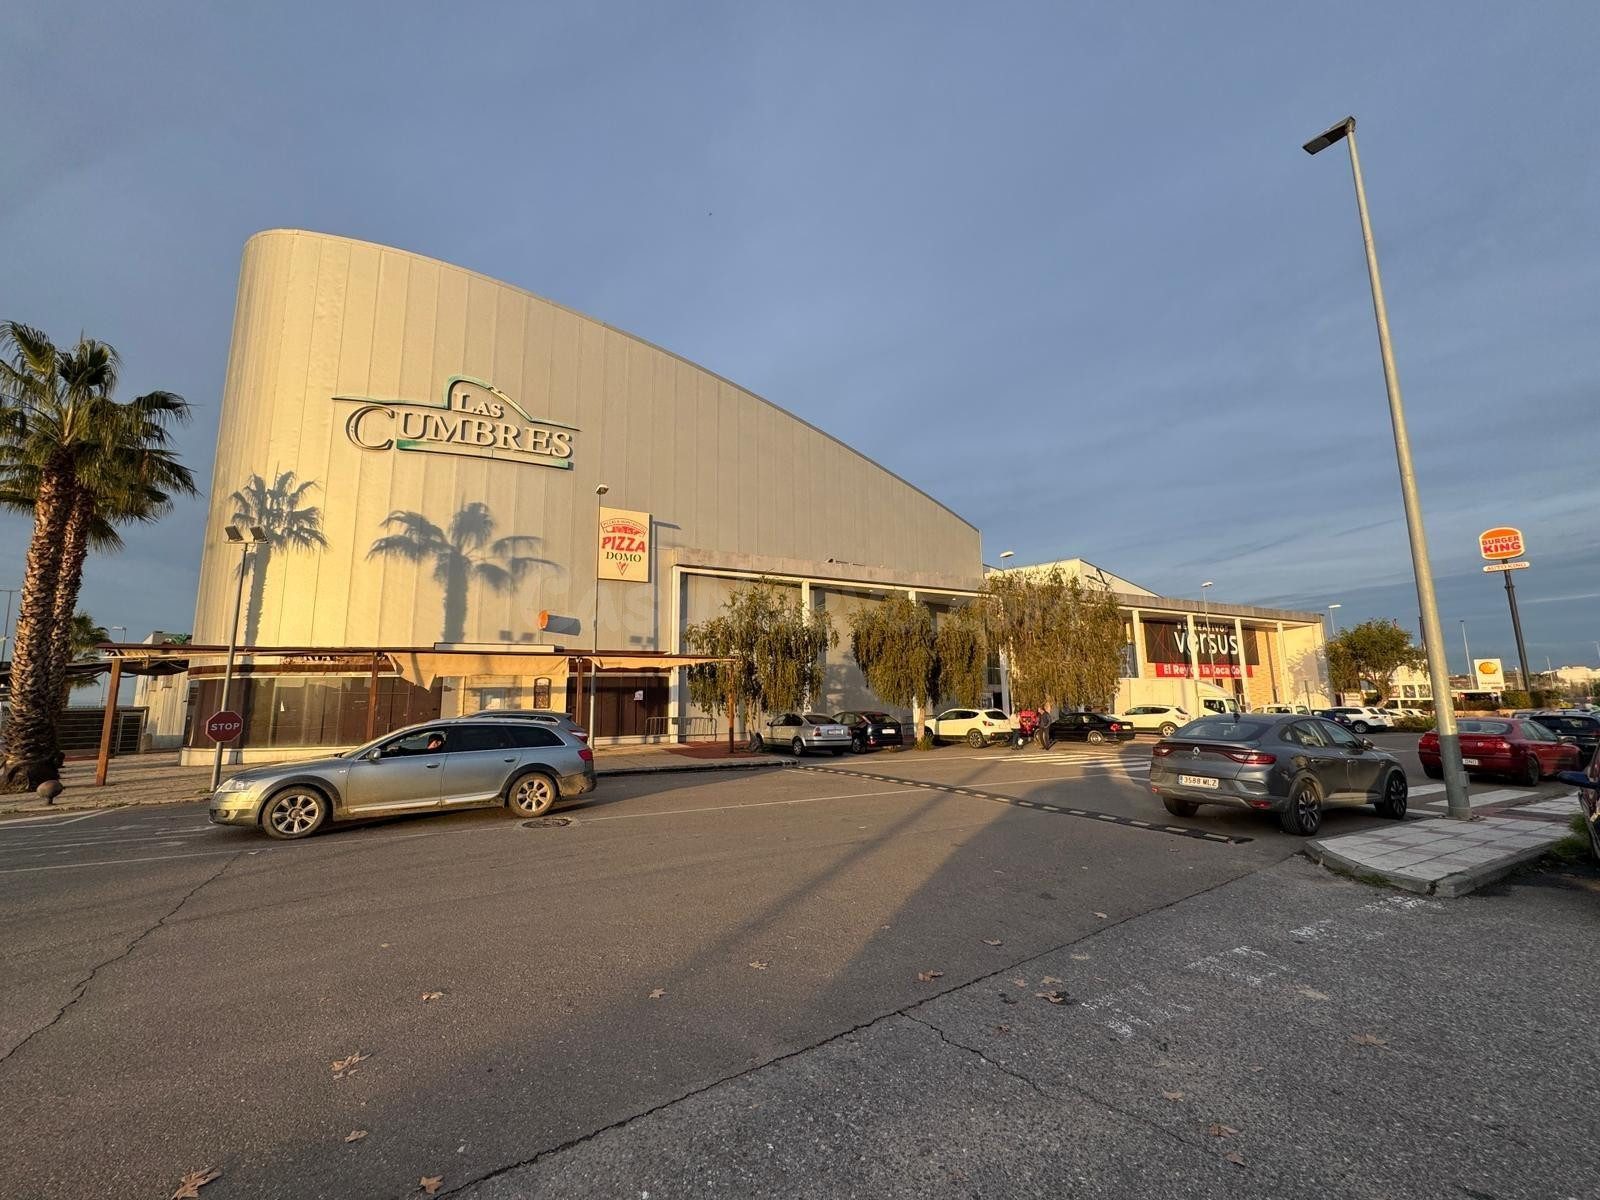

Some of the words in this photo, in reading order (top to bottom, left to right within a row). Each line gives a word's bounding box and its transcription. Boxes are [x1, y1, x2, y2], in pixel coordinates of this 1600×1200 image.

[452, 391, 504, 418] LAS
[345, 405, 573, 459] CUMBRES
[601, 535, 646, 553] PIZZA
[1481, 535, 1520, 546] BURGER
[1482, 541, 1521, 554] KING
[605, 551, 642, 563] DOMO
[1163, 663, 1171, 675] El
[1172, 664, 1188, 677] Rey
[1201, 664, 1210, 675] la
[210, 722, 240, 731] STOP
